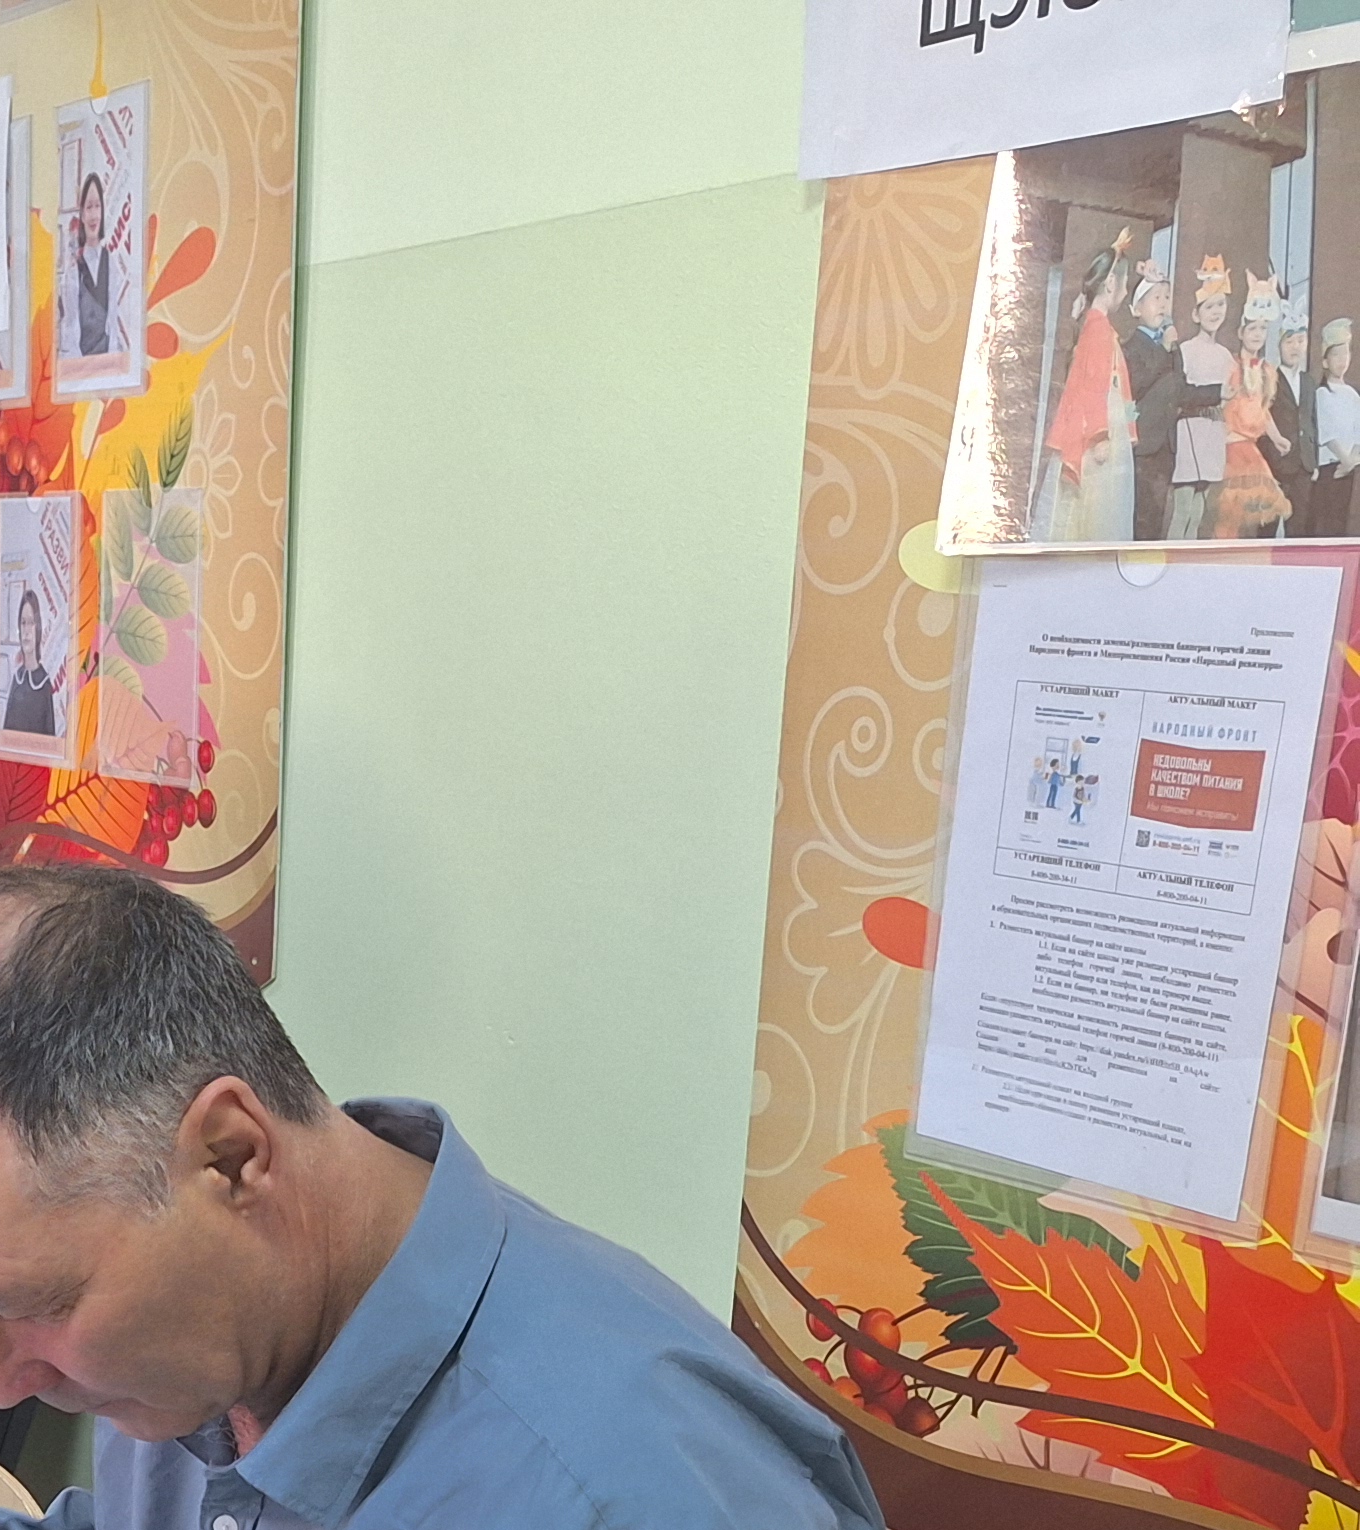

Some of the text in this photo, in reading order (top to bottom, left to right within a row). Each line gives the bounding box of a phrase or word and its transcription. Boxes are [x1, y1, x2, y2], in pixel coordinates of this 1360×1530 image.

[1040, 684, 1120, 699] УСТАРЕВШИЙ МАКЕТ
[1167, 694, 1258, 711] АКТУАЛЬНЫЙ МАКЕТ
[1152, 721, 1258, 743] НАРОДНЫЙ ФРОНТ
[1153, 753, 1212, 772] НЕДОВОЛЬНЫ
[1150, 769, 1244, 792] КАЧЕСТВОМ ПИТАНИЯ
[1148, 783, 1191, 802] В ШКОЛЕ?
[1013, 851, 1101, 872] УСТАРЕВШИЙ ТЕЛЕФОН
[1137, 871, 1235, 892] АКТУАЛЬНЫЙ ТЕЛЕФОН
